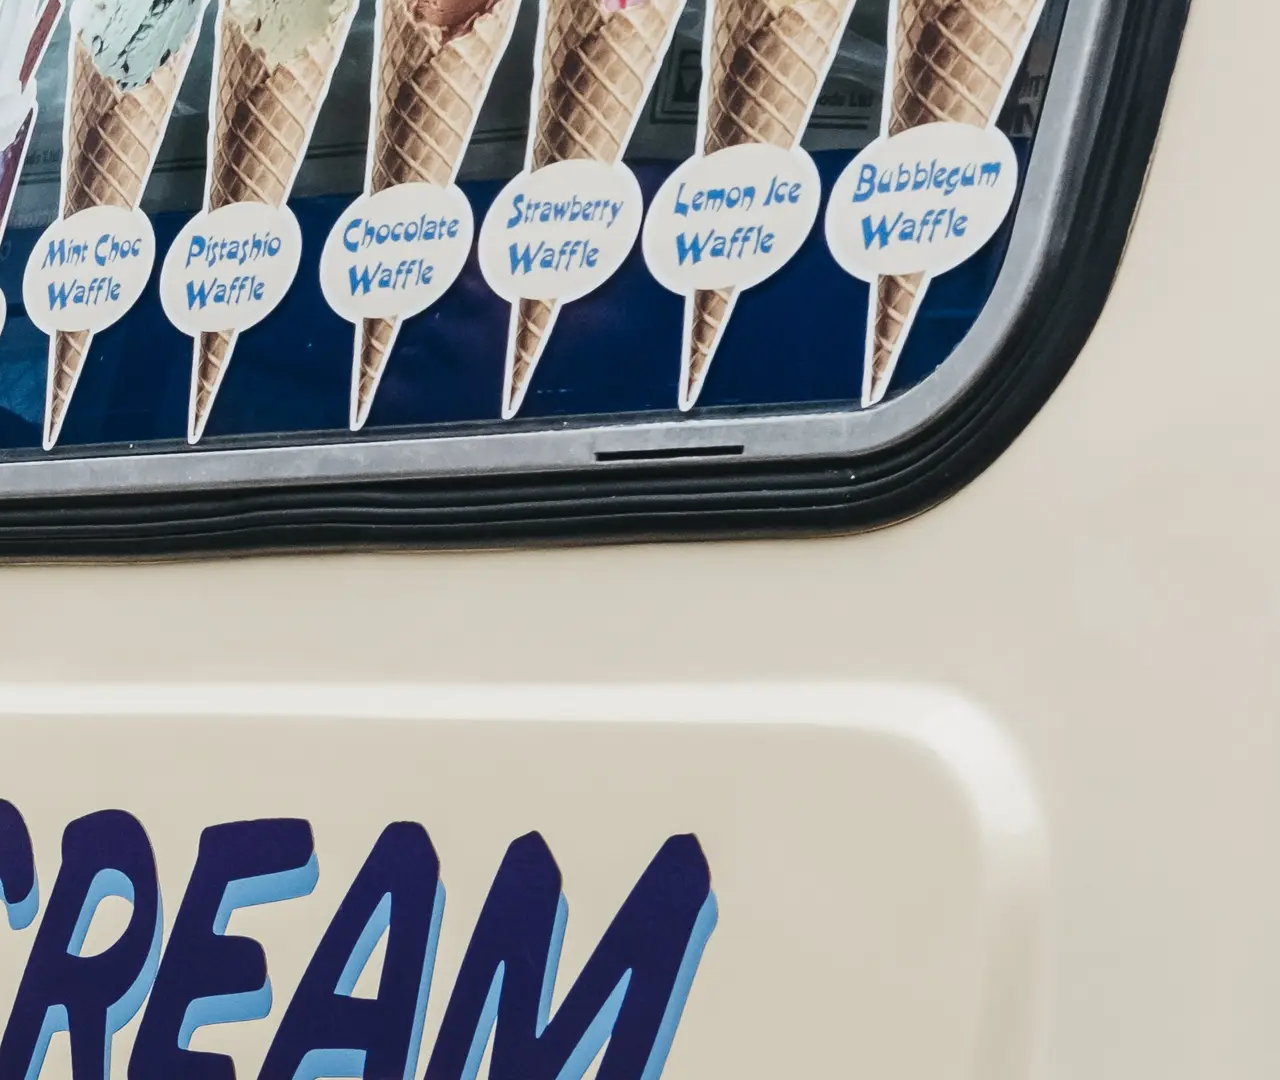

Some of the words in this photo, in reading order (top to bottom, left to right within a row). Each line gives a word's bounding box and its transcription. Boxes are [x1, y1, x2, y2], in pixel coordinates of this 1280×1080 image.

[674, 182, 755, 217] Lemon
[764, 176, 802, 208] Ice
[852, 158, 1002, 203] Bubblegum
[507, 192, 623, 230] Strawberry
[861, 209, 967, 251] Waffle
[41, 238, 89, 270] Mint
[94, 233, 142, 265] Choc
[185, 232, 281, 269] Pistashio
[342, 213, 460, 253] Chocolate
[675, 229, 774, 267] Waffle
[508, 239, 598, 276] Waffle
[47, 276, 122, 312] Waffle
[185, 275, 265, 311] Waffle
[348, 259, 434, 297] Waffle
